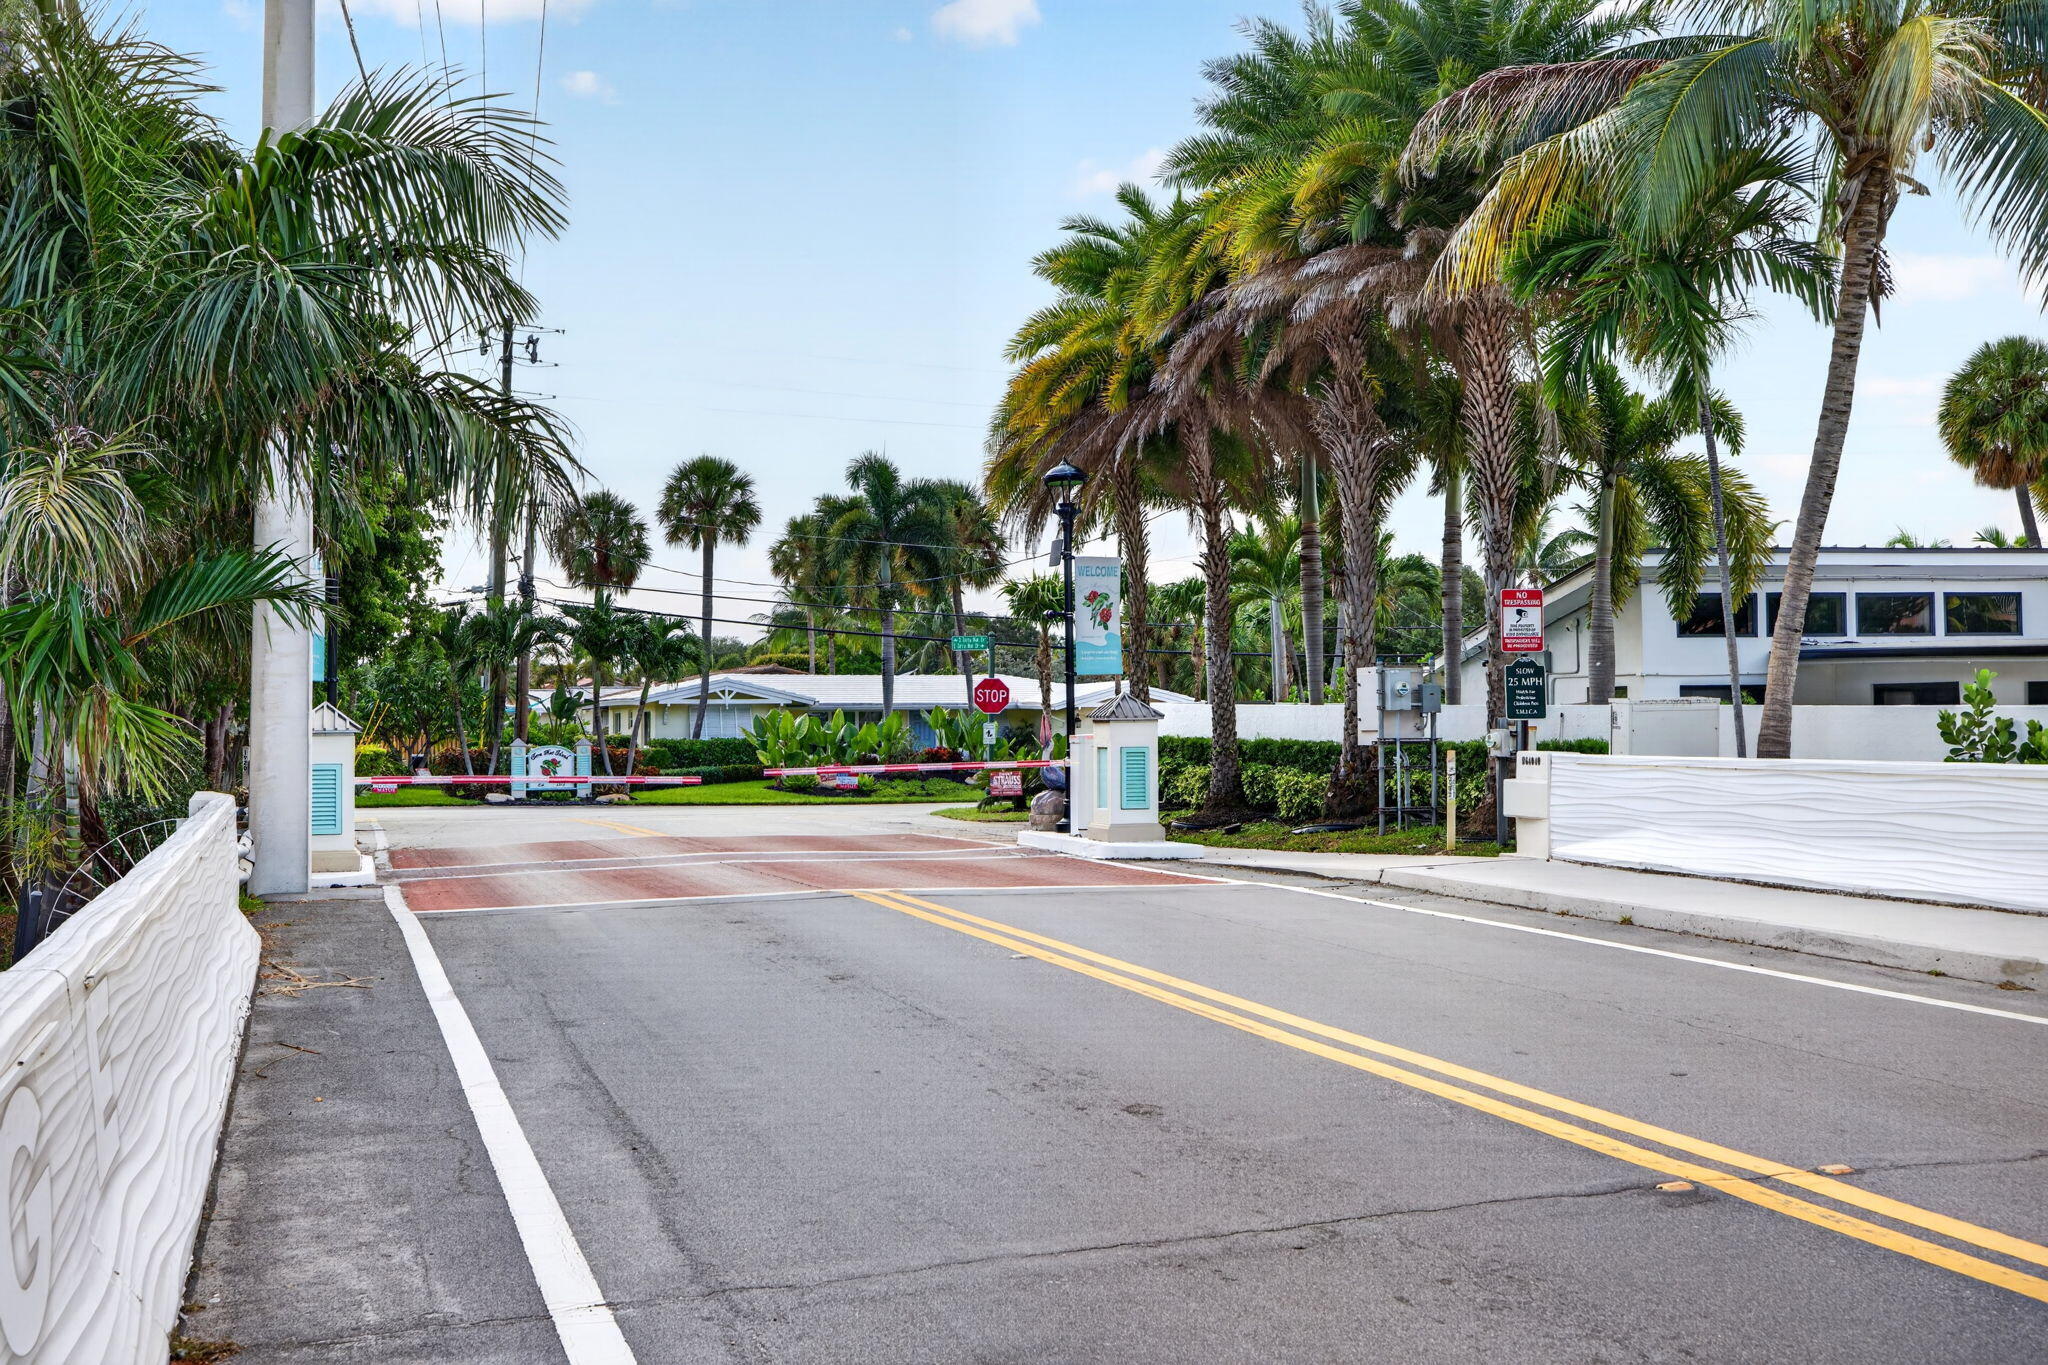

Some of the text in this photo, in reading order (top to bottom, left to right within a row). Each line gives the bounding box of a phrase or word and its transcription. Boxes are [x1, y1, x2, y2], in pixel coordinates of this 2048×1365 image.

[1077, 565, 1118, 577] WELCOME
[1516, 591, 1528, 599] NO
[1515, 667, 1535, 675] SLOW
[1508, 677, 1543, 686] 25 MPH
[976, 689, 1007, 703] STOP
[993, 775, 1021, 785] STRAUSS
